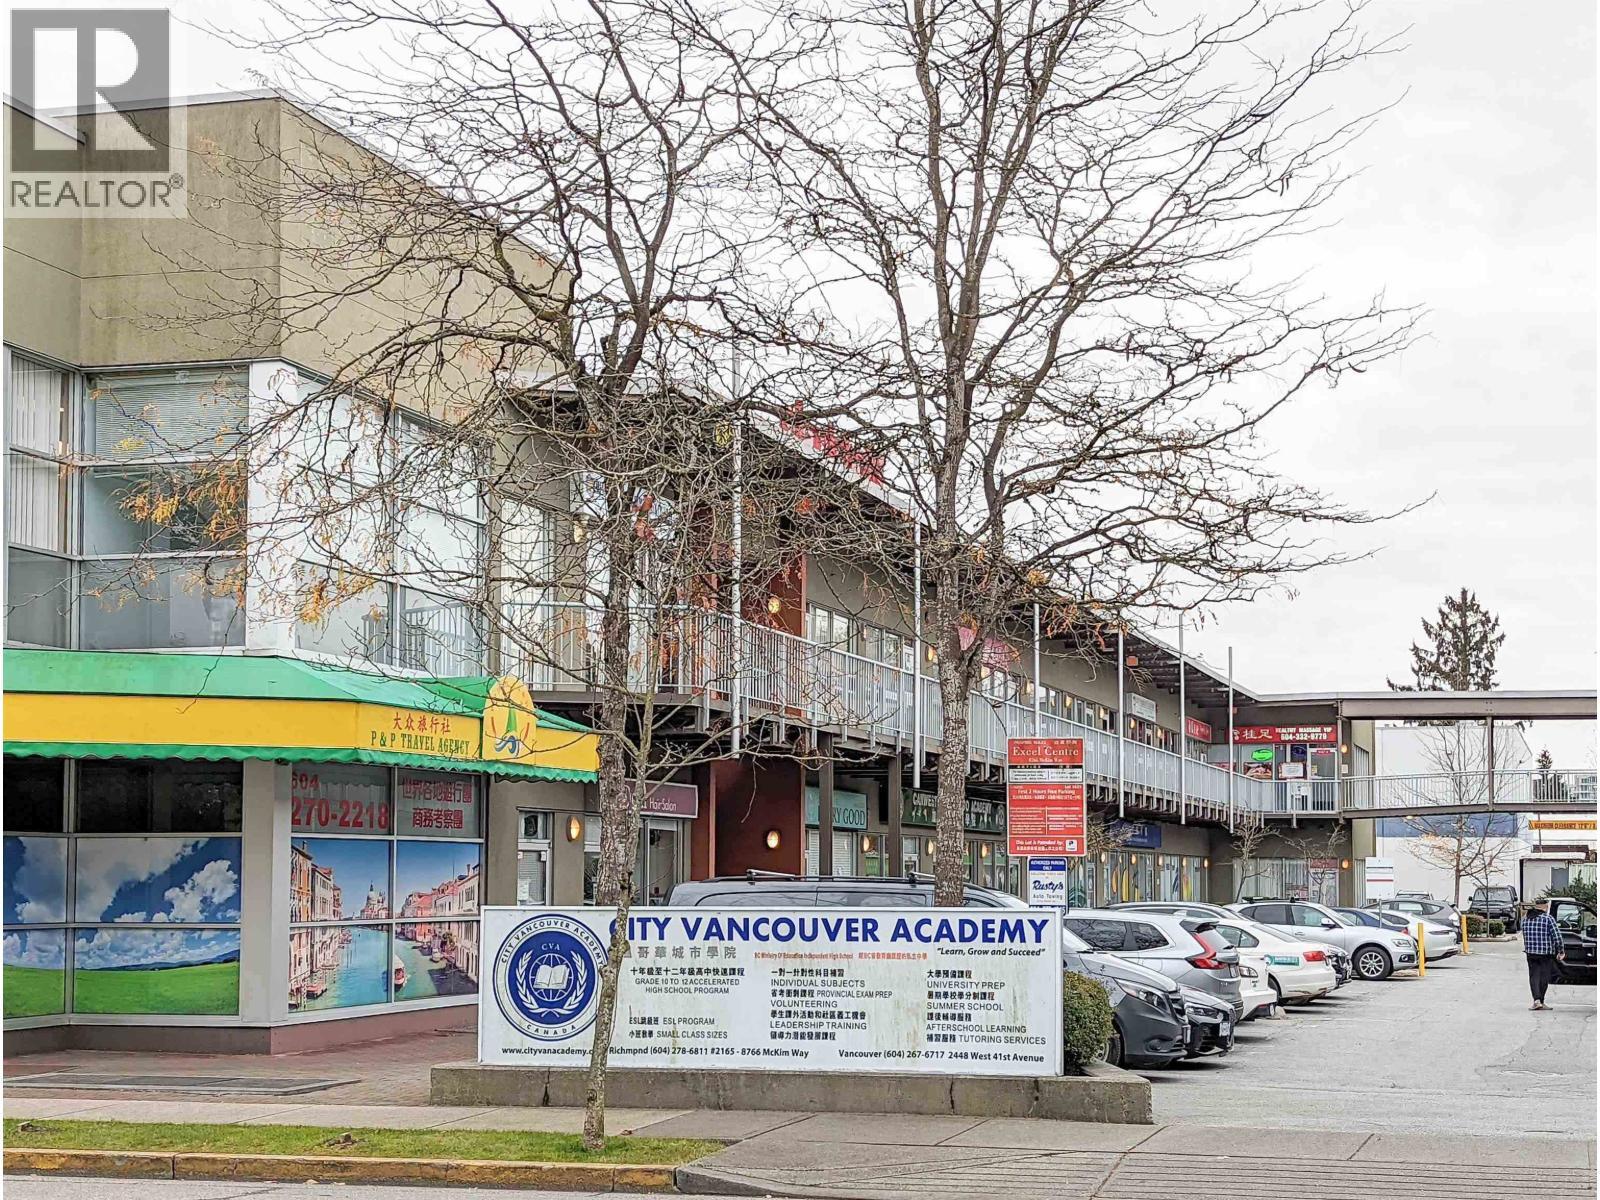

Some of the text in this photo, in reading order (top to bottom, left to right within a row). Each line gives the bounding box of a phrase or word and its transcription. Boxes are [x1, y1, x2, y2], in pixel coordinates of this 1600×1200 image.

[371, 730, 471, 755] P & P TRAVEL AGENCY
[1013, 746, 1041, 756] Excel
[292, 796, 388, 830] 270-2218
[843, 808, 866, 826] GOOD
[1032, 880, 1064, 893] Rusty's
[681, 917, 881, 942] VANCOUVER
[890, 918, 1050, 944] ACADEMY
[501, 920, 604, 966] CITY VANCOUVER ACADEMY
[542, 943, 560, 951] CVA
[968, 948, 990, 956] Grow
[991, 948, 1007, 956] and
[682, 978, 688, 986] 12
[689, 978, 740, 986] ACCELERATED
[771, 979, 866, 988] INDIVIDUAL SUBJECTS
[926, 981, 1006, 990] UNIVERSITY PREP
[646, 986, 663, 994] HIGH
[664, 986, 692, 994] SCHOOL
[816, 990, 855, 998] PROVINCIAL
[875, 991, 892, 999] PREP
[770, 1000, 838, 1008] VOLUNTEERING
[926, 1002, 1004, 1012] SUMMER SCHOOL
[663, 1017, 715, 1026] ESL PROGRAM
[770, 1021, 867, 1030] LEADERSHIP TRAINING
[526, 1024, 576, 1036] CANADA
[926, 1024, 1027, 1034] AFTERSCHOOL LEARNING
[681, 1031, 705, 1039] CLASS
[706, 1031, 728, 1039] SIZES
[959, 1034, 1046, 1045] TUTORING SERVICES
[502, 1046, 594, 1056] www.cityvanacademy.c
[650, 1046, 670, 1056] (604)
[672, 1046, 708, 1056] 278-6811
[710, 1047, 735, 1056] #2165
[741, 1048, 761, 1056] 8766
[762, 1048, 790, 1057] McKim
[791, 1048, 810, 1059] Way
[838, 1050, 1045, 1062] Vancouver (604) 267-6717 2448 West 41st Avenue
